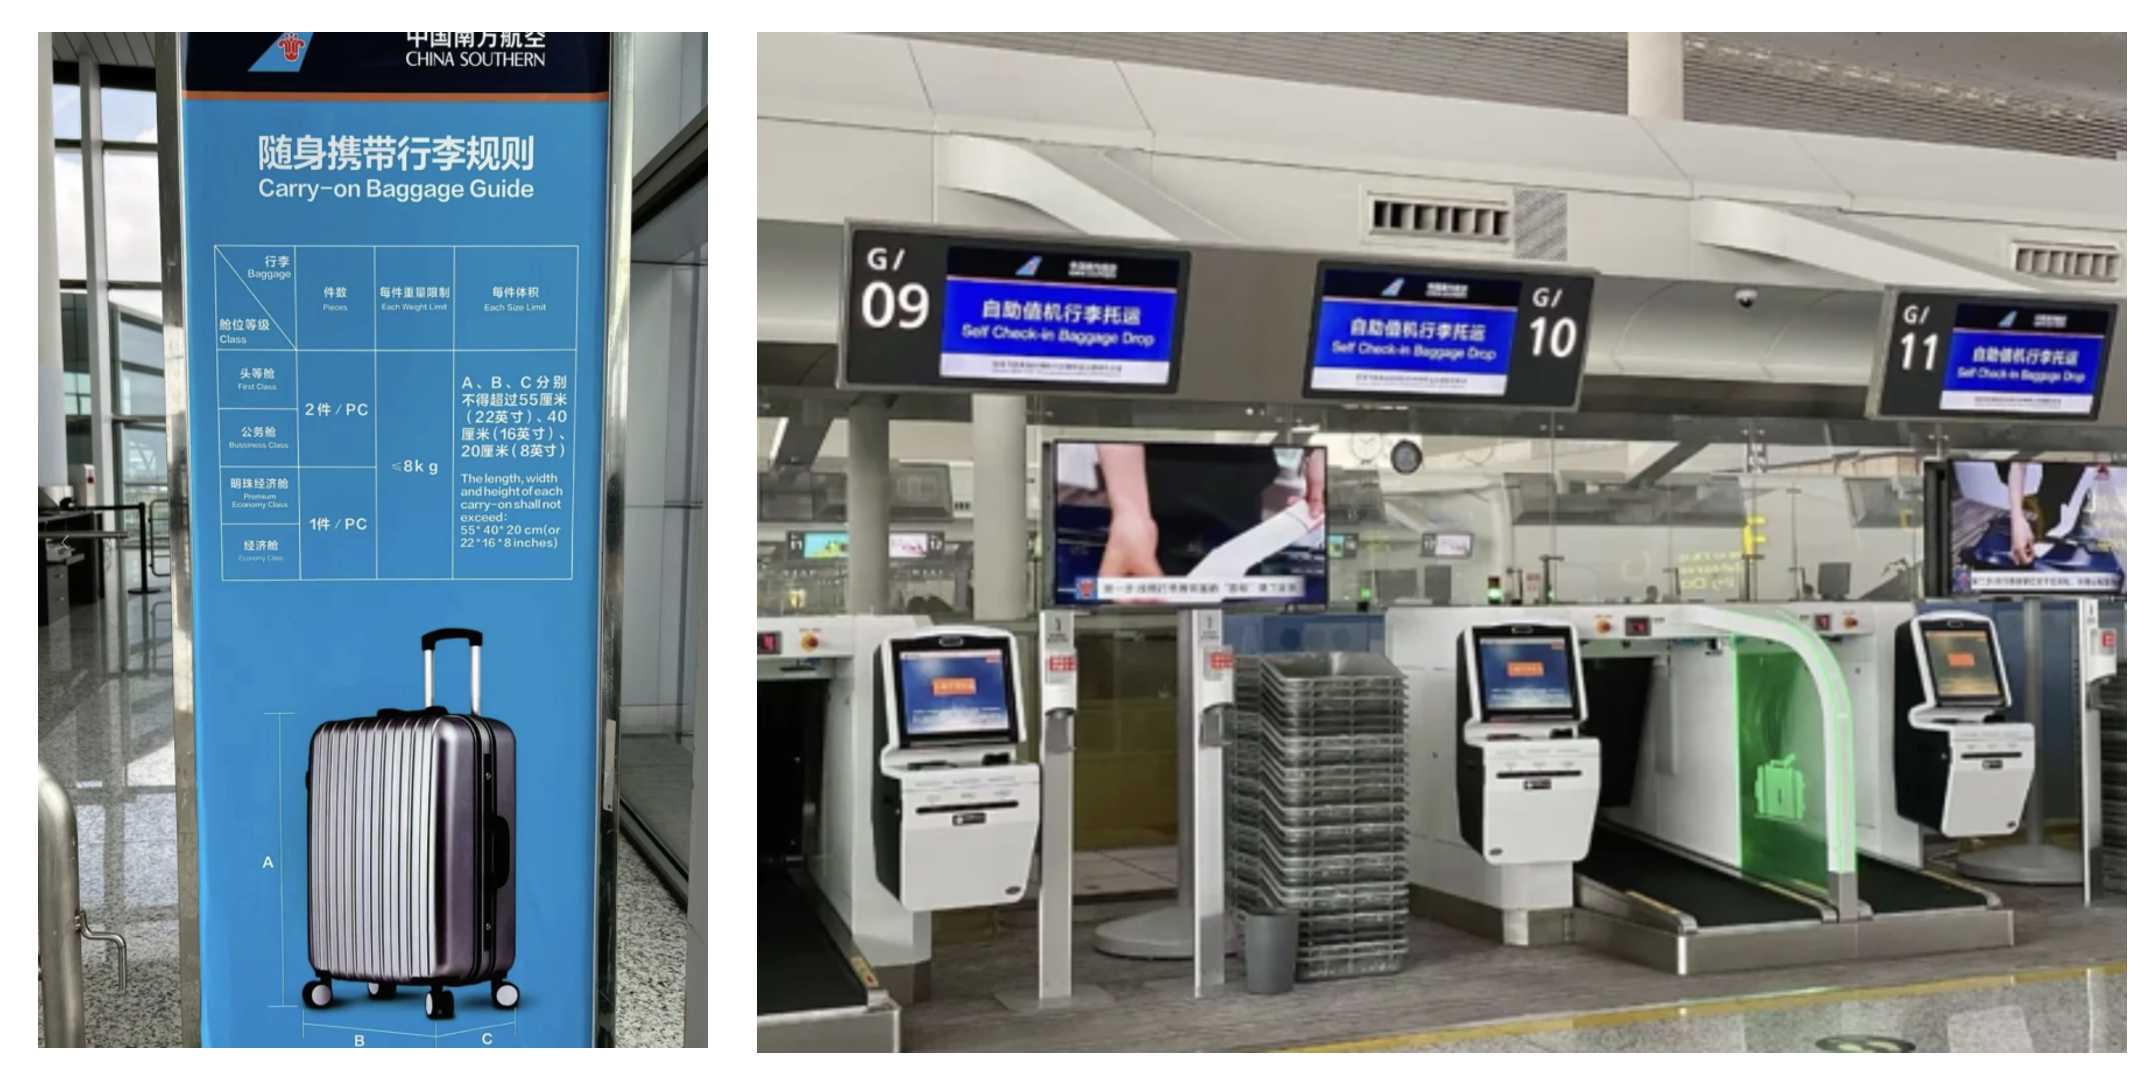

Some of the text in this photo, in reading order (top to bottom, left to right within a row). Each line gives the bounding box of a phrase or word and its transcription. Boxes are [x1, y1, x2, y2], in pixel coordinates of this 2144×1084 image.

[405, 51, 545, 67] CHINA SOUTHERN
[258, 135, 534, 171] 随身携带行李规则
[258, 179, 535, 202] Carry-on Baggage Guide
[265, 255, 290, 268] 行李
[867, 248, 905, 271] G/
[247, 268, 292, 281] Baggage
[323, 286, 347, 298] 件数
[379, 286, 450, 299] 每件重量限制
[492, 286, 540, 299] 每件体积
[1532, 287, 1562, 308] G/
[381, 303, 448, 312] Each Weight Limit
[484, 303, 547, 312] Each Size Limit
[861, 281, 930, 329] 09
[982, 298, 1141, 327] 自助值机行李托运
[1903, 304, 1930, 325] G/
[219, 318, 270, 331] 舱位等级
[1350, 318, 1486, 342] 自助值机行李托运
[219, 335, 247, 344] Class
[961, 324, 1155, 347] Self Check-in Baggage Drop
[1529, 316, 1577, 358] 10
[1332, 340, 1496, 361] Self Check-in Baggage Drop
[1901, 332, 1939, 371] 11
[239, 368, 275, 380] 头等舱
[238, 383, 277, 391] First Class
[461, 392, 568, 407] 不得超过55厘米
[241, 426, 277, 438] 公务舱
[268, 441, 289, 449] Class
[230, 478, 289, 489] 明珠经济舱
[461, 473, 558, 486] The length, width
[460, 486, 563, 498] and height of each
[460, 499, 561, 511] carry-on shall not
[460, 512, 508, 522] exceed:
[244, 540, 279, 551] 经济舱
[513, 537, 558, 549] inches)
[262, 856, 274, 869] A
[354, 1034, 365, 1047] B
[481, 1033, 493, 1045] C
